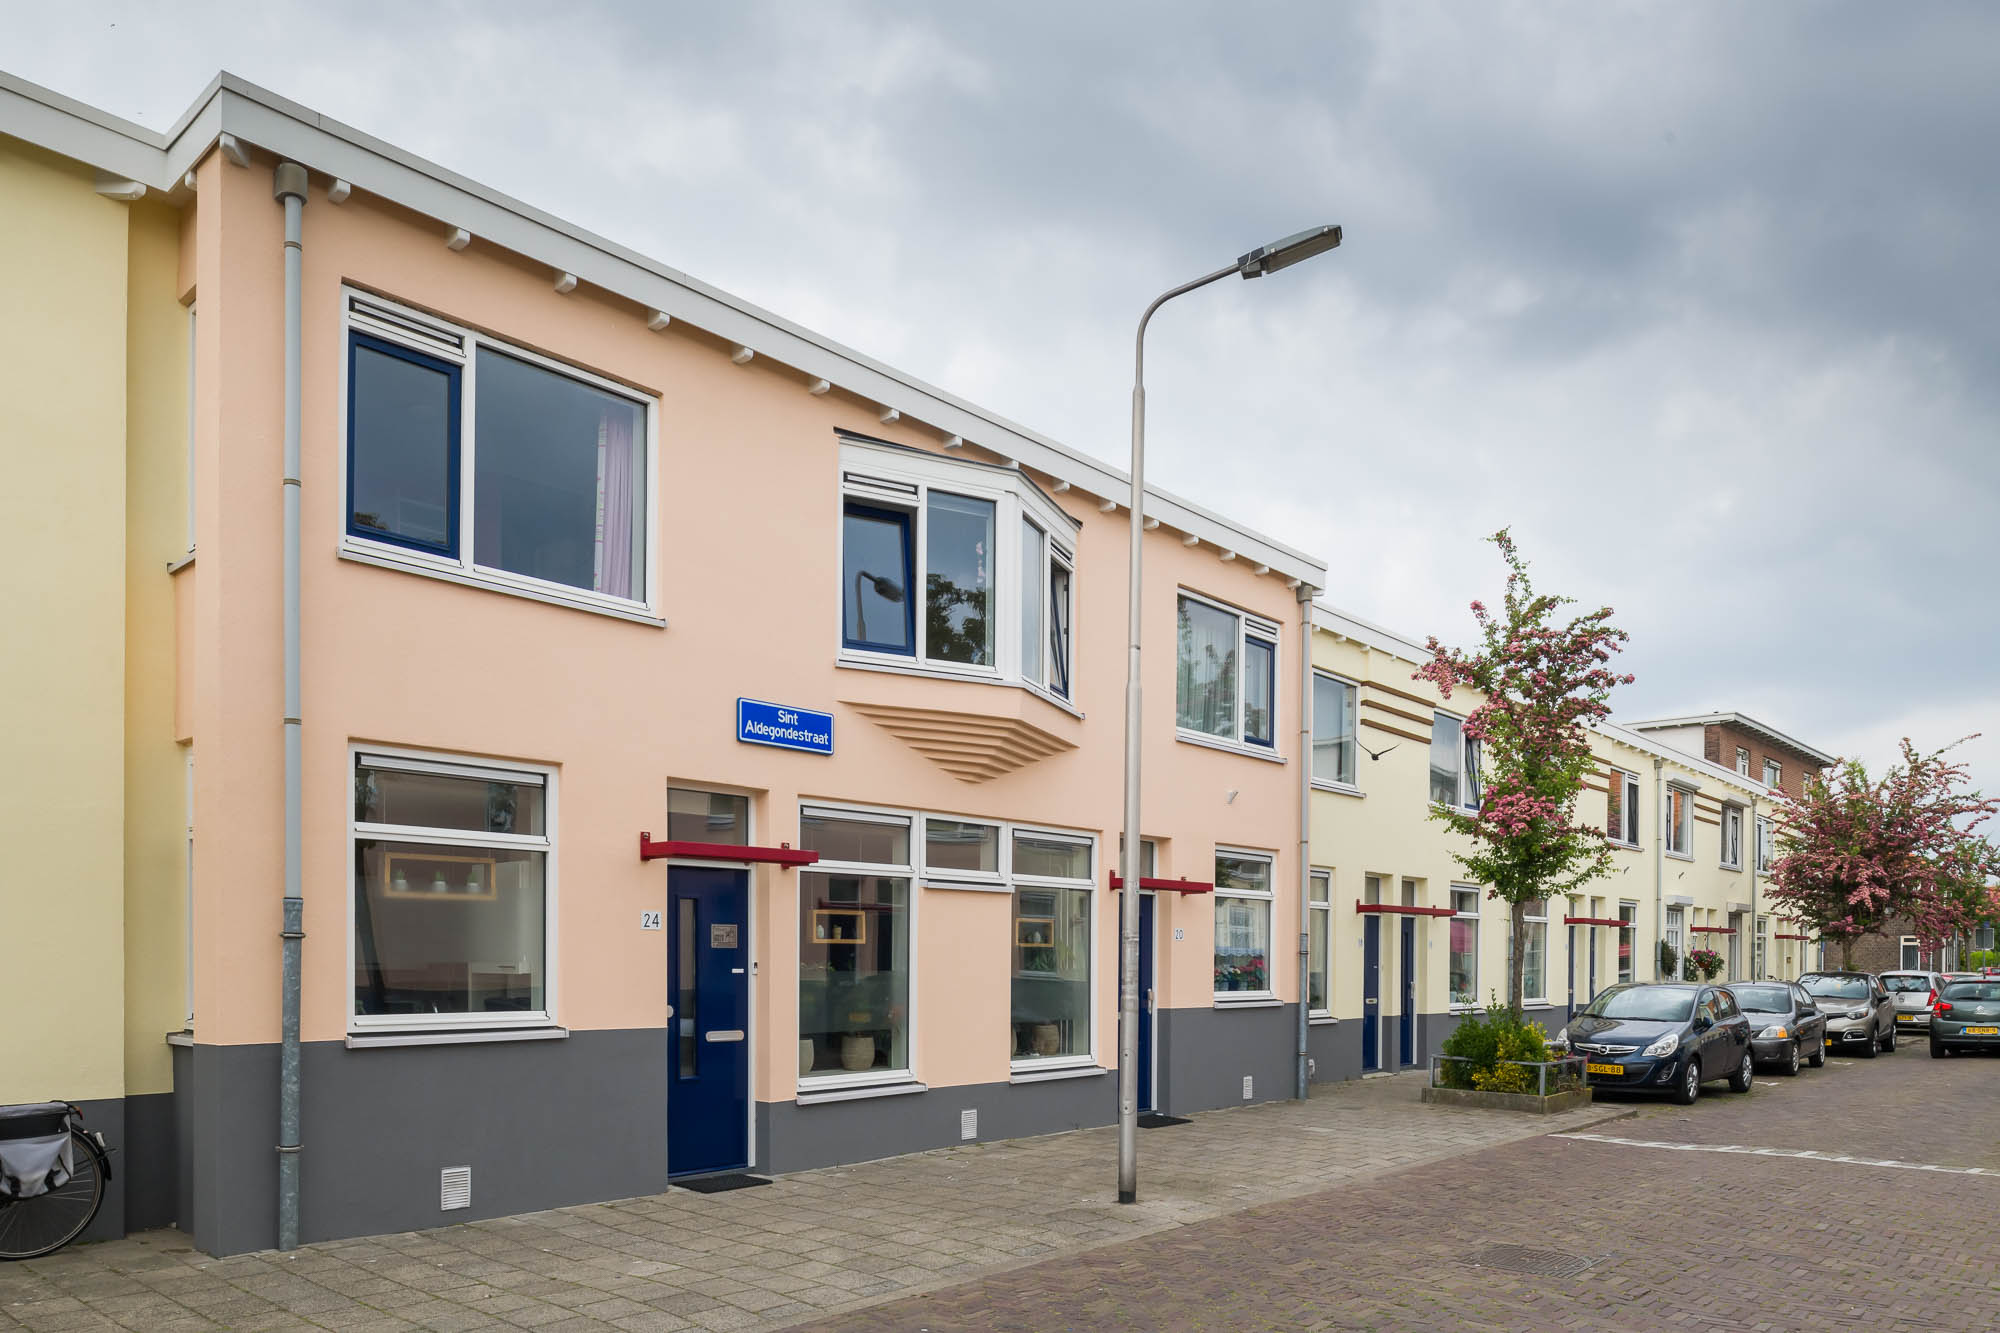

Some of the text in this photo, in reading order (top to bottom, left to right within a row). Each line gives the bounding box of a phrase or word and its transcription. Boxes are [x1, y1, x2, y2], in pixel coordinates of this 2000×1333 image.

[778, 710, 798, 725] Sint
[745, 719, 829, 745] Aldegondestraat
[643, 913, 660, 928] 24
